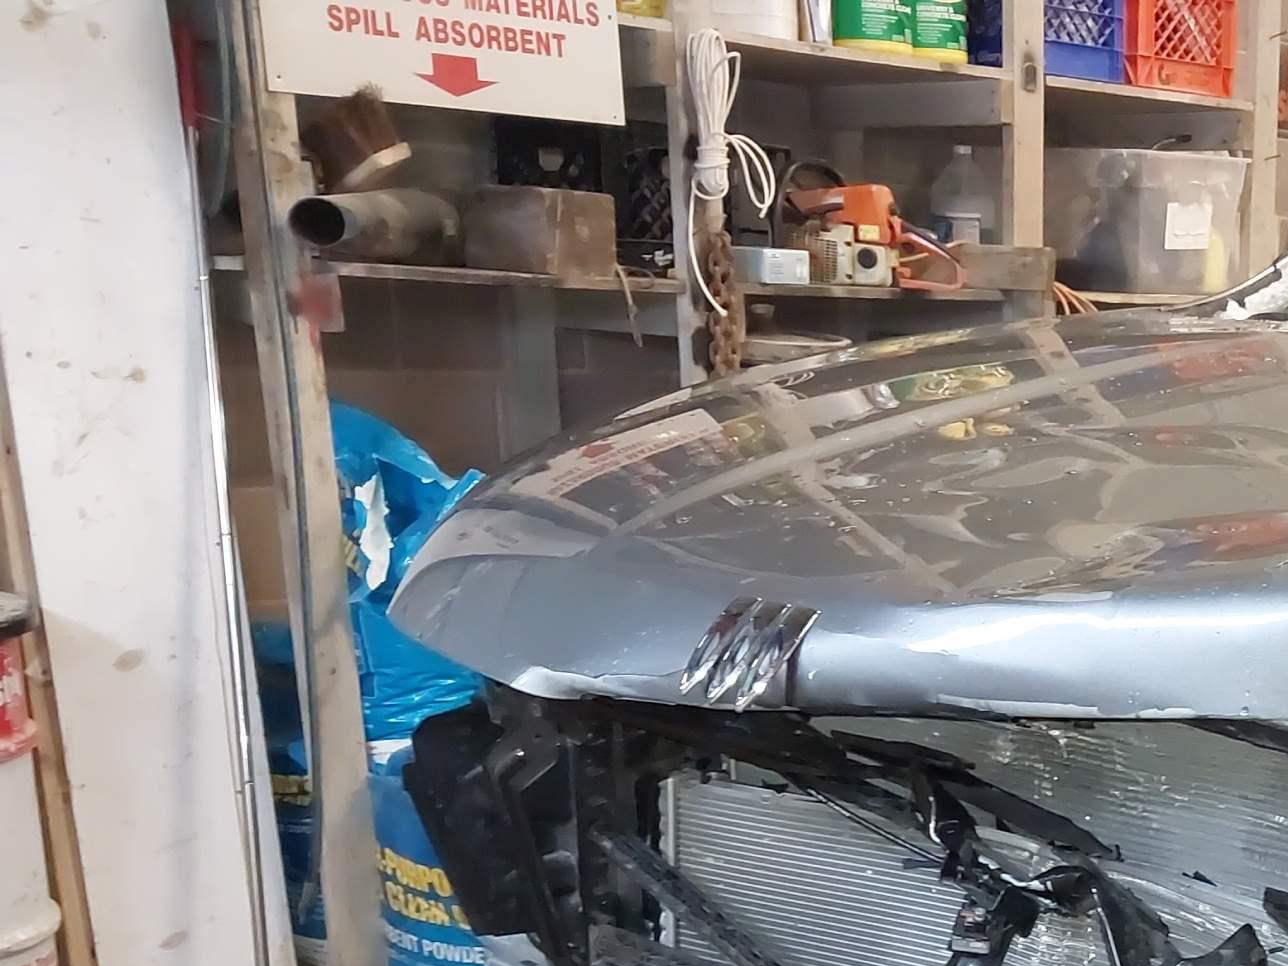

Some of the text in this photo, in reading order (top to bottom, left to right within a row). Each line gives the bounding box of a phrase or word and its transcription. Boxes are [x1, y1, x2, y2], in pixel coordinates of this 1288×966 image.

[327, 4, 567, 58] SPILL ABSORBENT
[421, 937, 486, 965] POWDE
